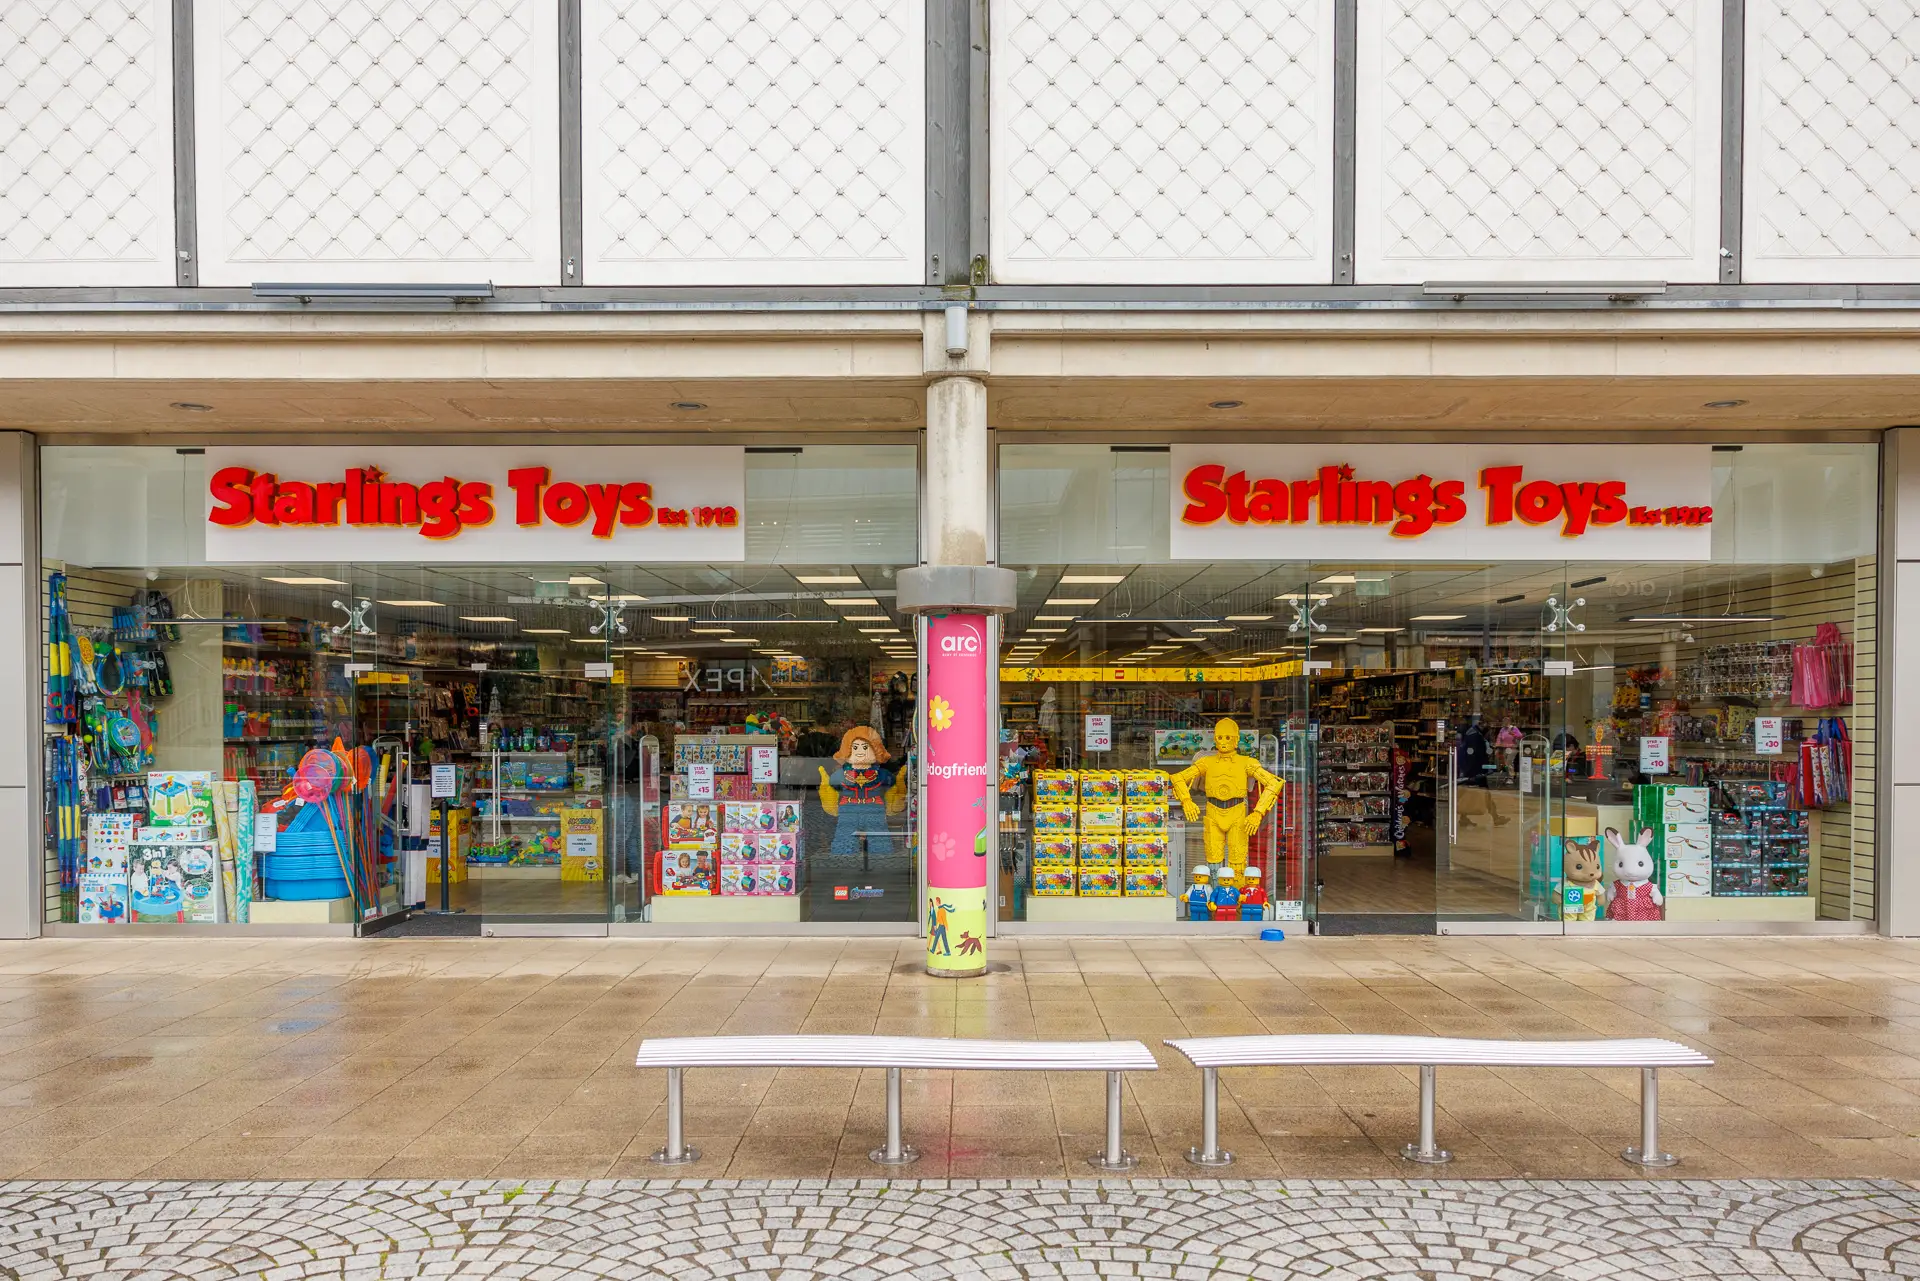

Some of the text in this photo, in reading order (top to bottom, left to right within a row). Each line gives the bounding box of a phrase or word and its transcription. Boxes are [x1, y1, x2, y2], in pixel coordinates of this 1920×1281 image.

[209, 465, 739, 541] Starlings Toys Est 1912
[1181, 463, 1467, 539] Starlings
[1480, 465, 1627, 539] Toys
[941, 635, 978, 652] arc
